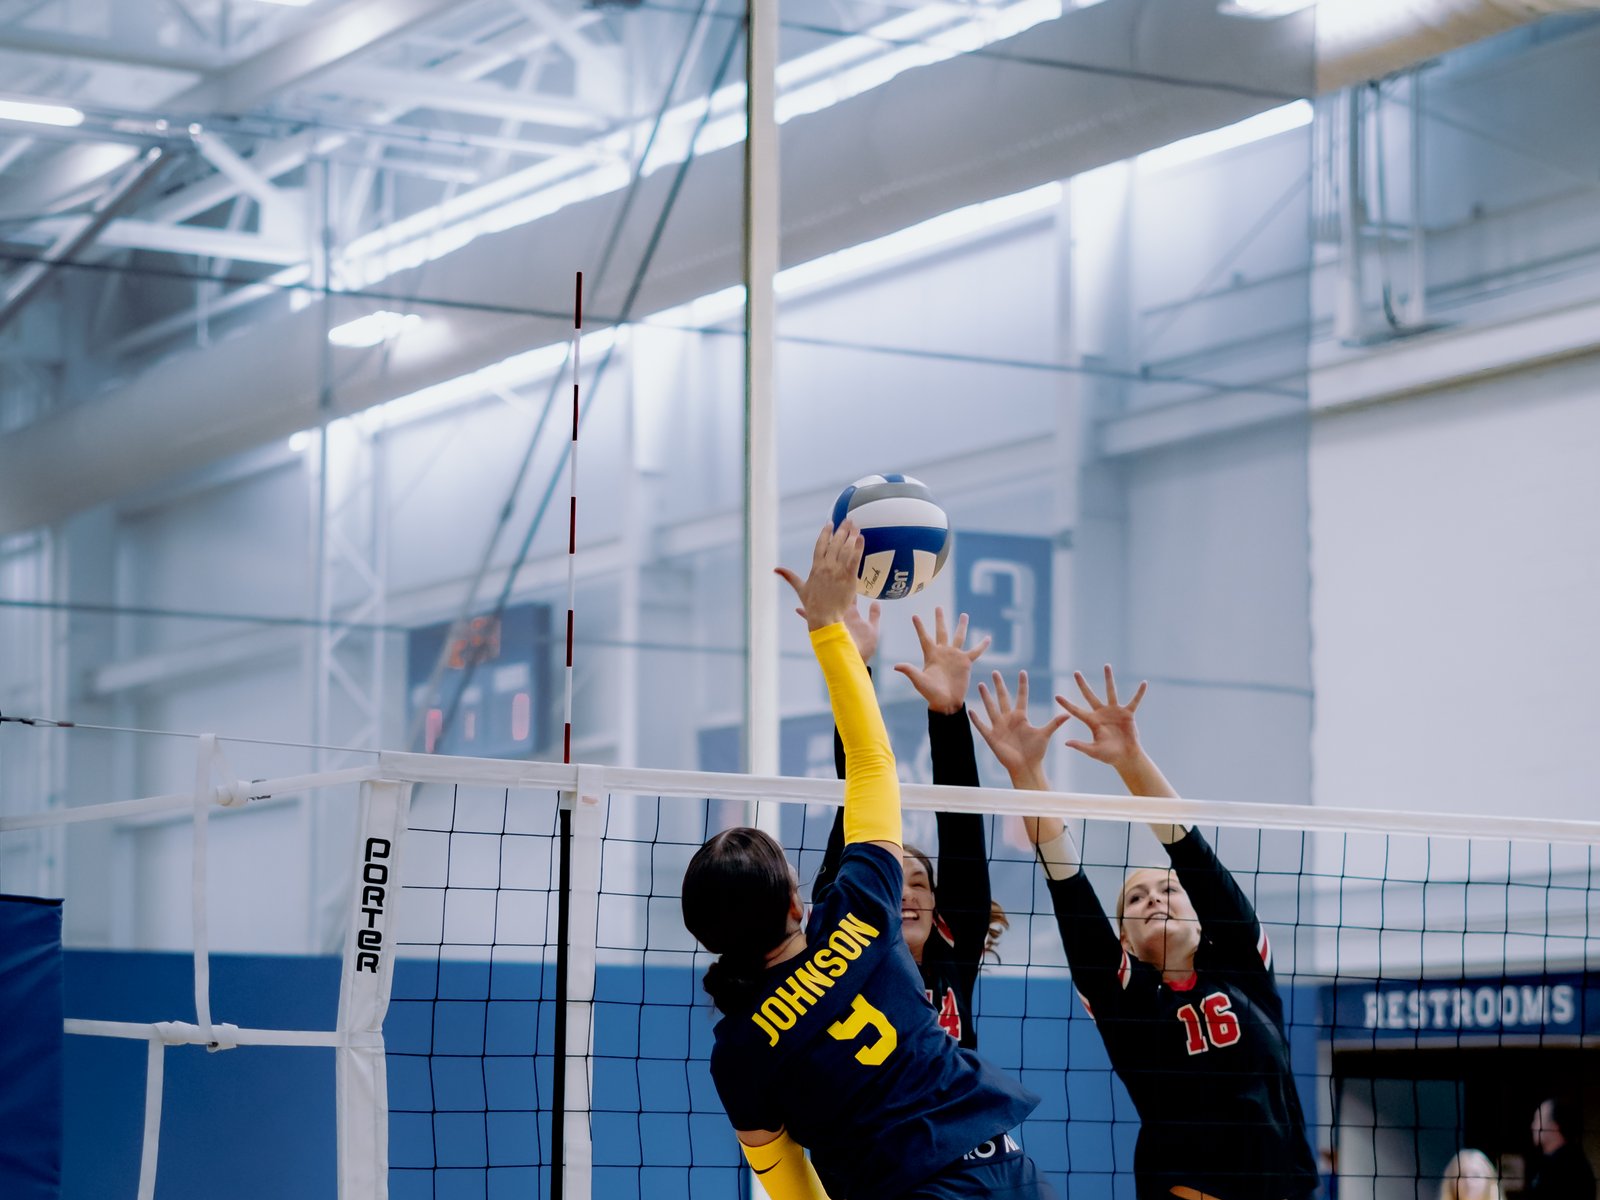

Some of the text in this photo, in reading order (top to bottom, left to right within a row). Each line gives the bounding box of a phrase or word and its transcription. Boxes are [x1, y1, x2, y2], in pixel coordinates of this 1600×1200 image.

[357, 837, 391, 974] PORTER
[751, 912, 880, 1047] JOHNSON
[1177, 991, 1241, 1056] 16
[1363, 984, 1575, 1030] RESTROOMS
